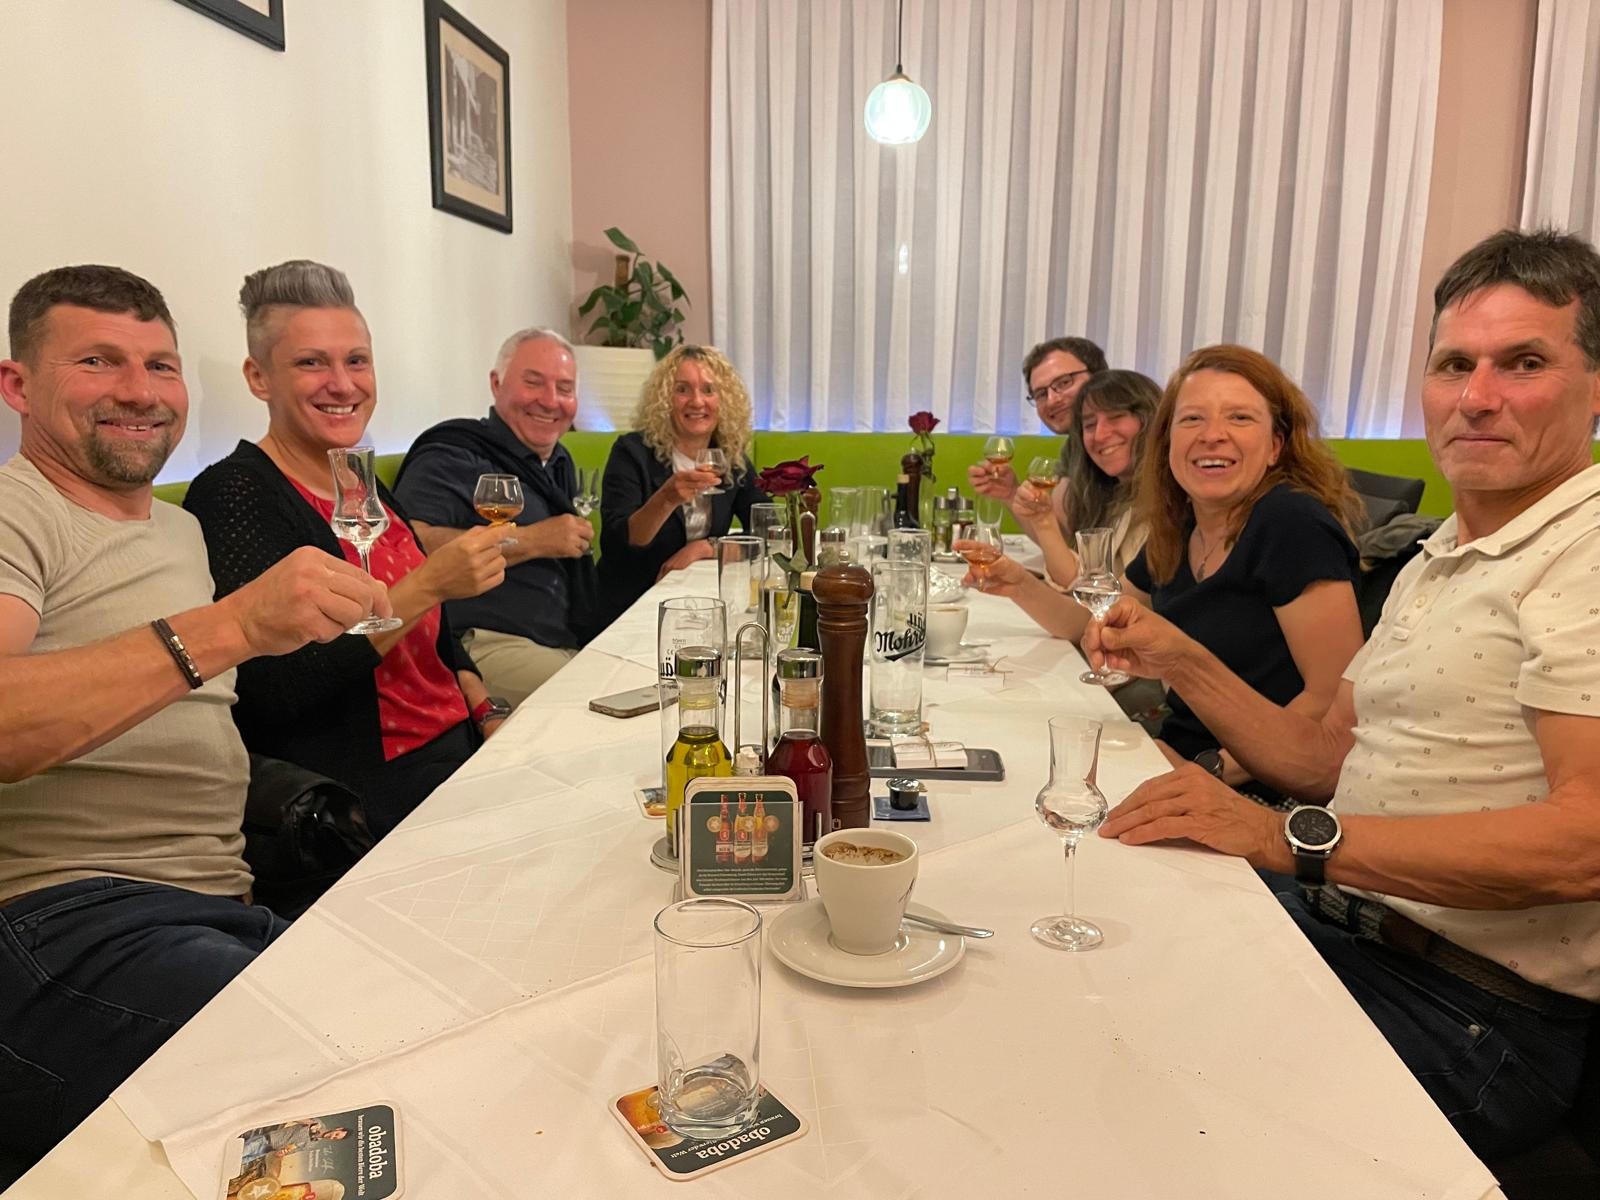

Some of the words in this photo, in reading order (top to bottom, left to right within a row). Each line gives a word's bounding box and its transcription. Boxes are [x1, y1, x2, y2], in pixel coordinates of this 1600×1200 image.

[875, 628, 926, 652] Mohre
[357, 1114, 365, 1131] brauen
[357, 1132, 365, 1140] wir
[695, 1126, 771, 1159] obadoba
[357, 1147, 365, 1162] besten
[368, 1125, 388, 1180] obadoba
[671, 1151, 688, 1159] Welt
[357, 1162, 365, 1175] Biere
[357, 1175, 365, 1183] der
[357, 1183, 366, 1196] Welt
